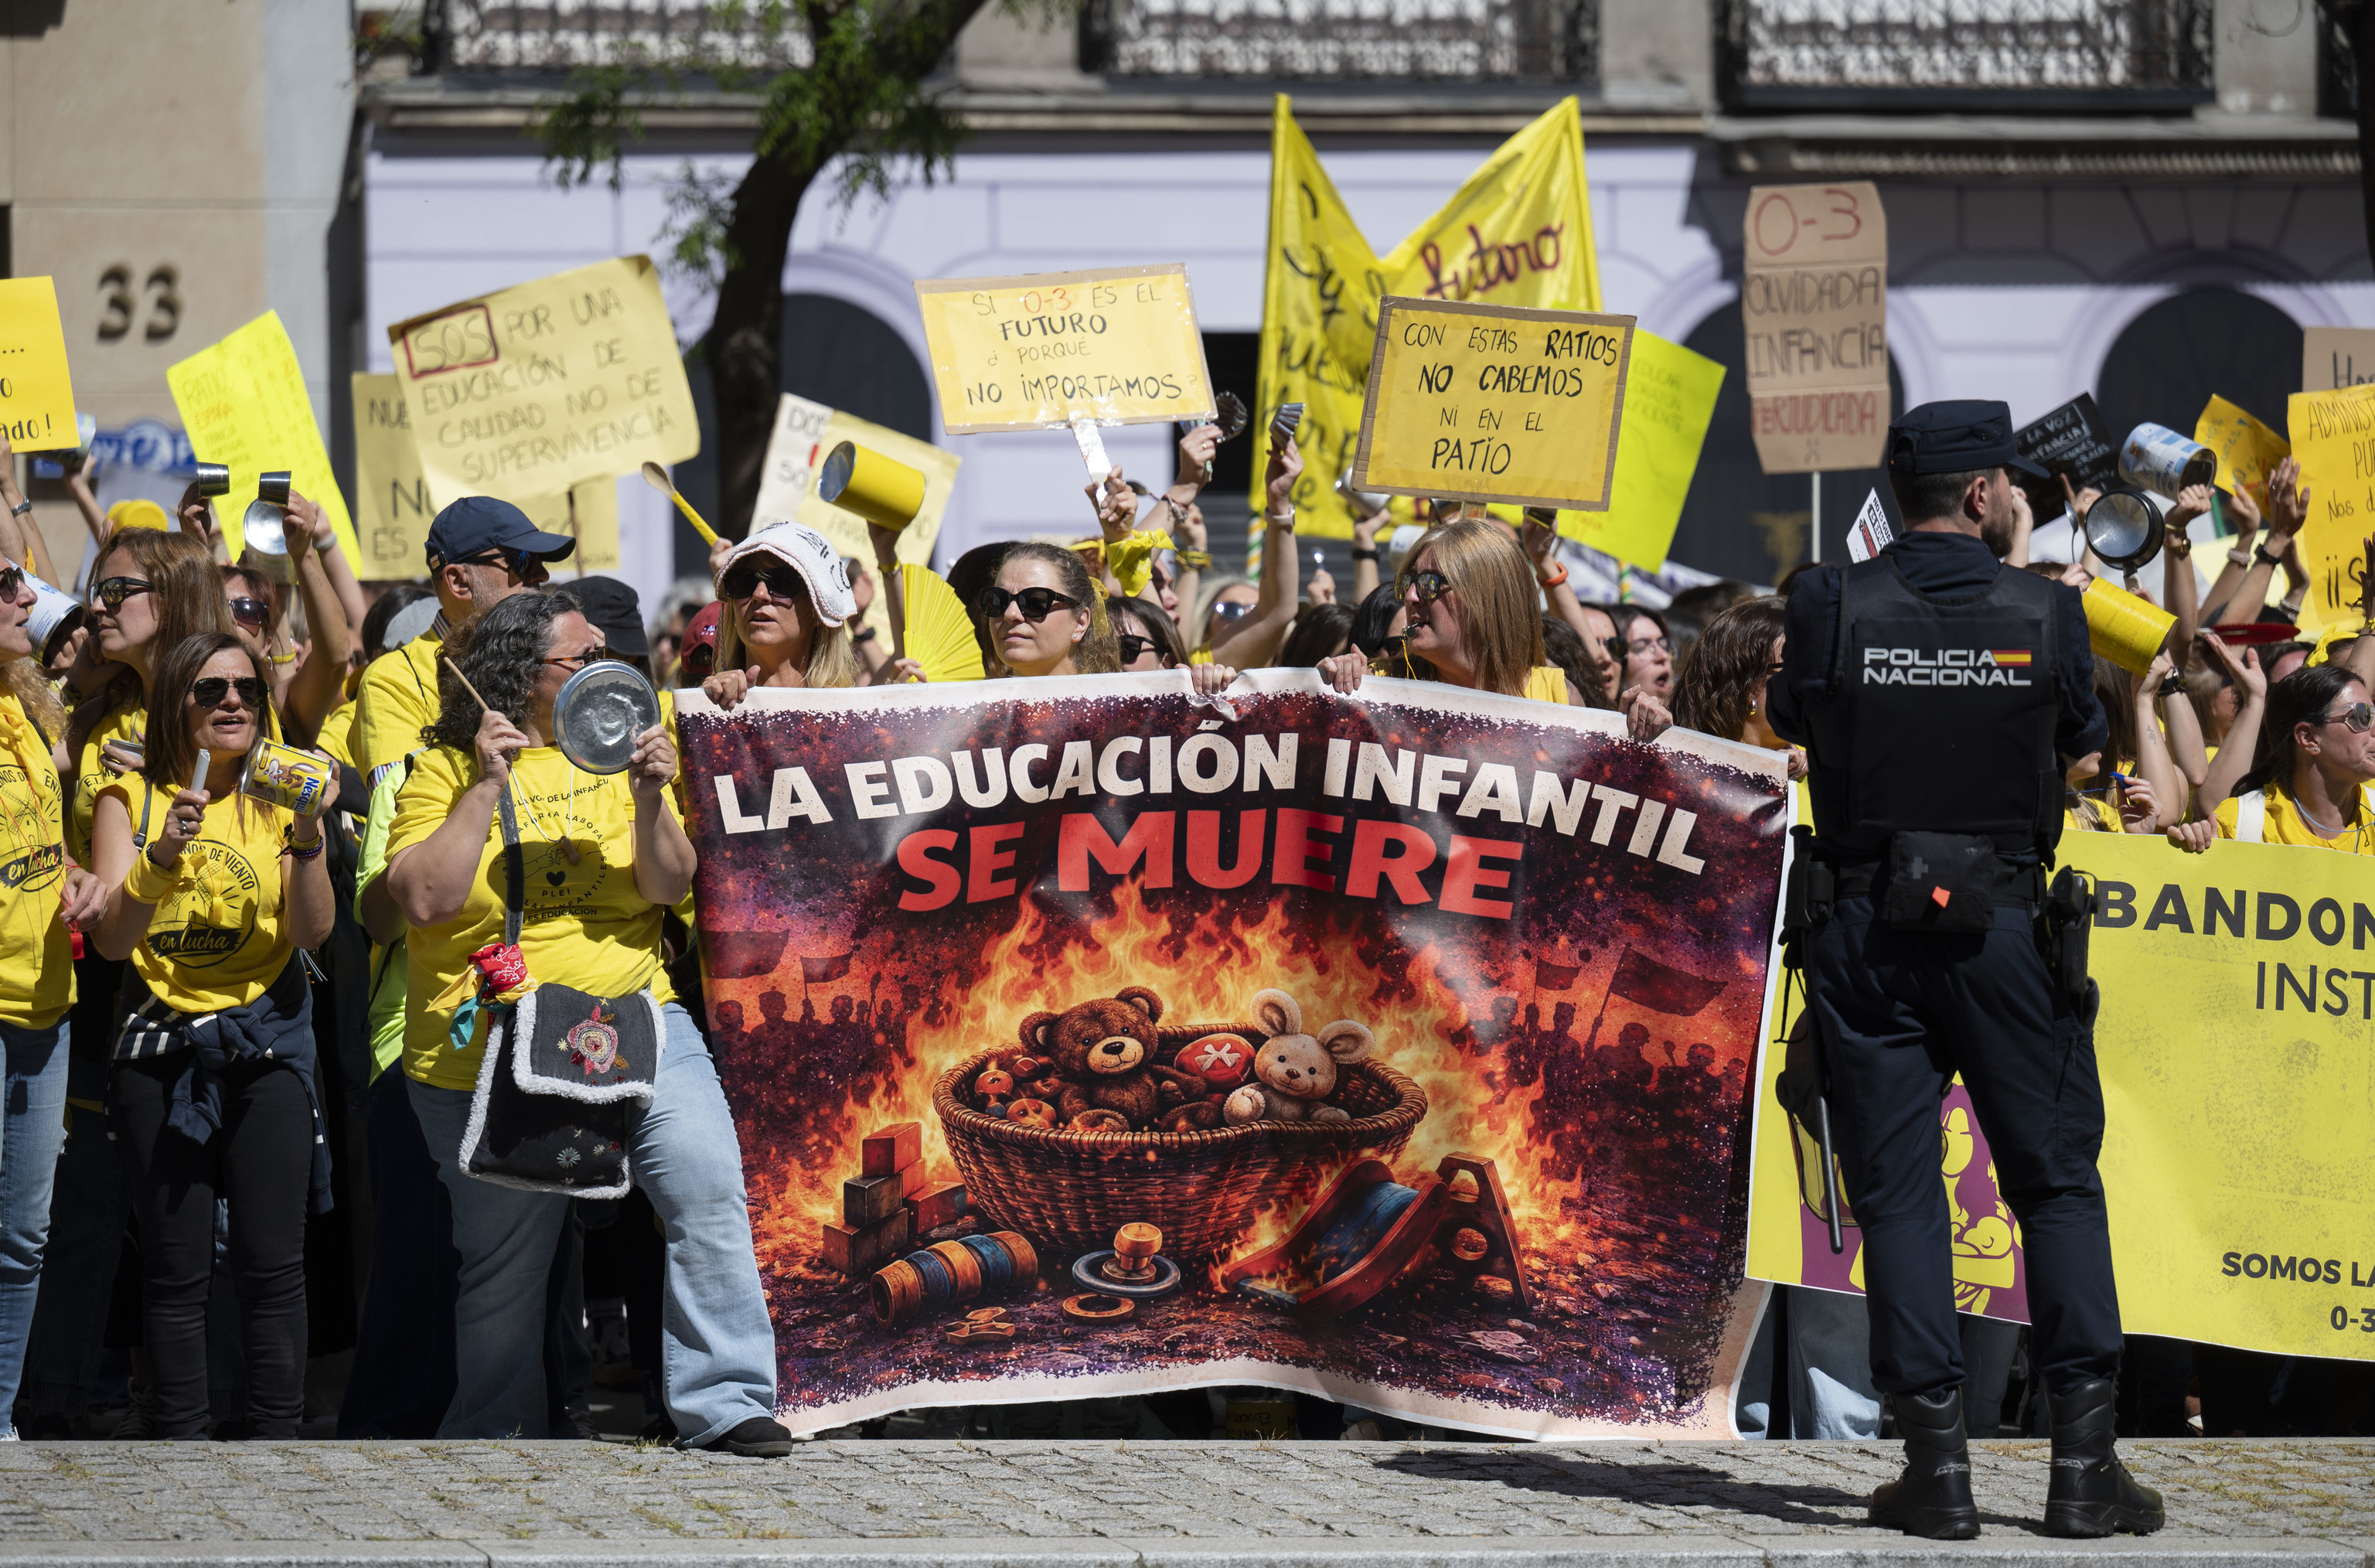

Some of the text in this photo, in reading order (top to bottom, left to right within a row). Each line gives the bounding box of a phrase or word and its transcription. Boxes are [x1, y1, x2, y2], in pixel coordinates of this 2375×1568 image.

[97, 268, 179, 343] 33
[972, 283, 1162, 315] SI 0-3 ES EL
[413, 286, 626, 374] SOS POR UNA
[998, 312, 1107, 341] FUTURO
[593, 338, 627, 369] DE
[1018, 337, 1091, 364] PORQUÉ
[1404, 322, 1617, 366] CON ESTAS RATIOS
[566, 385, 608, 418] NO
[626, 366, 663, 401] DE
[968, 382, 1003, 406] NO
[1419, 363, 1583, 397] NO CABEMOS
[1478, 407, 1503, 431] EN
[1525, 411, 1545, 432] EL
[1863, 666, 2033, 686] NACIONAL
[547, 794, 560, 803] DE
[714, 720, 1706, 875] LA EDUCACIÓN INFANTIL
[209, 848, 223, 862] DE
[225, 851, 255, 891] VIENTO
[896, 806, 1525, 921] SE MUERE
[542, 888, 571, 898] PLEI
[159, 923, 230, 951] en lucha
[2221, 1252, 2342, 1285] SOMOS
